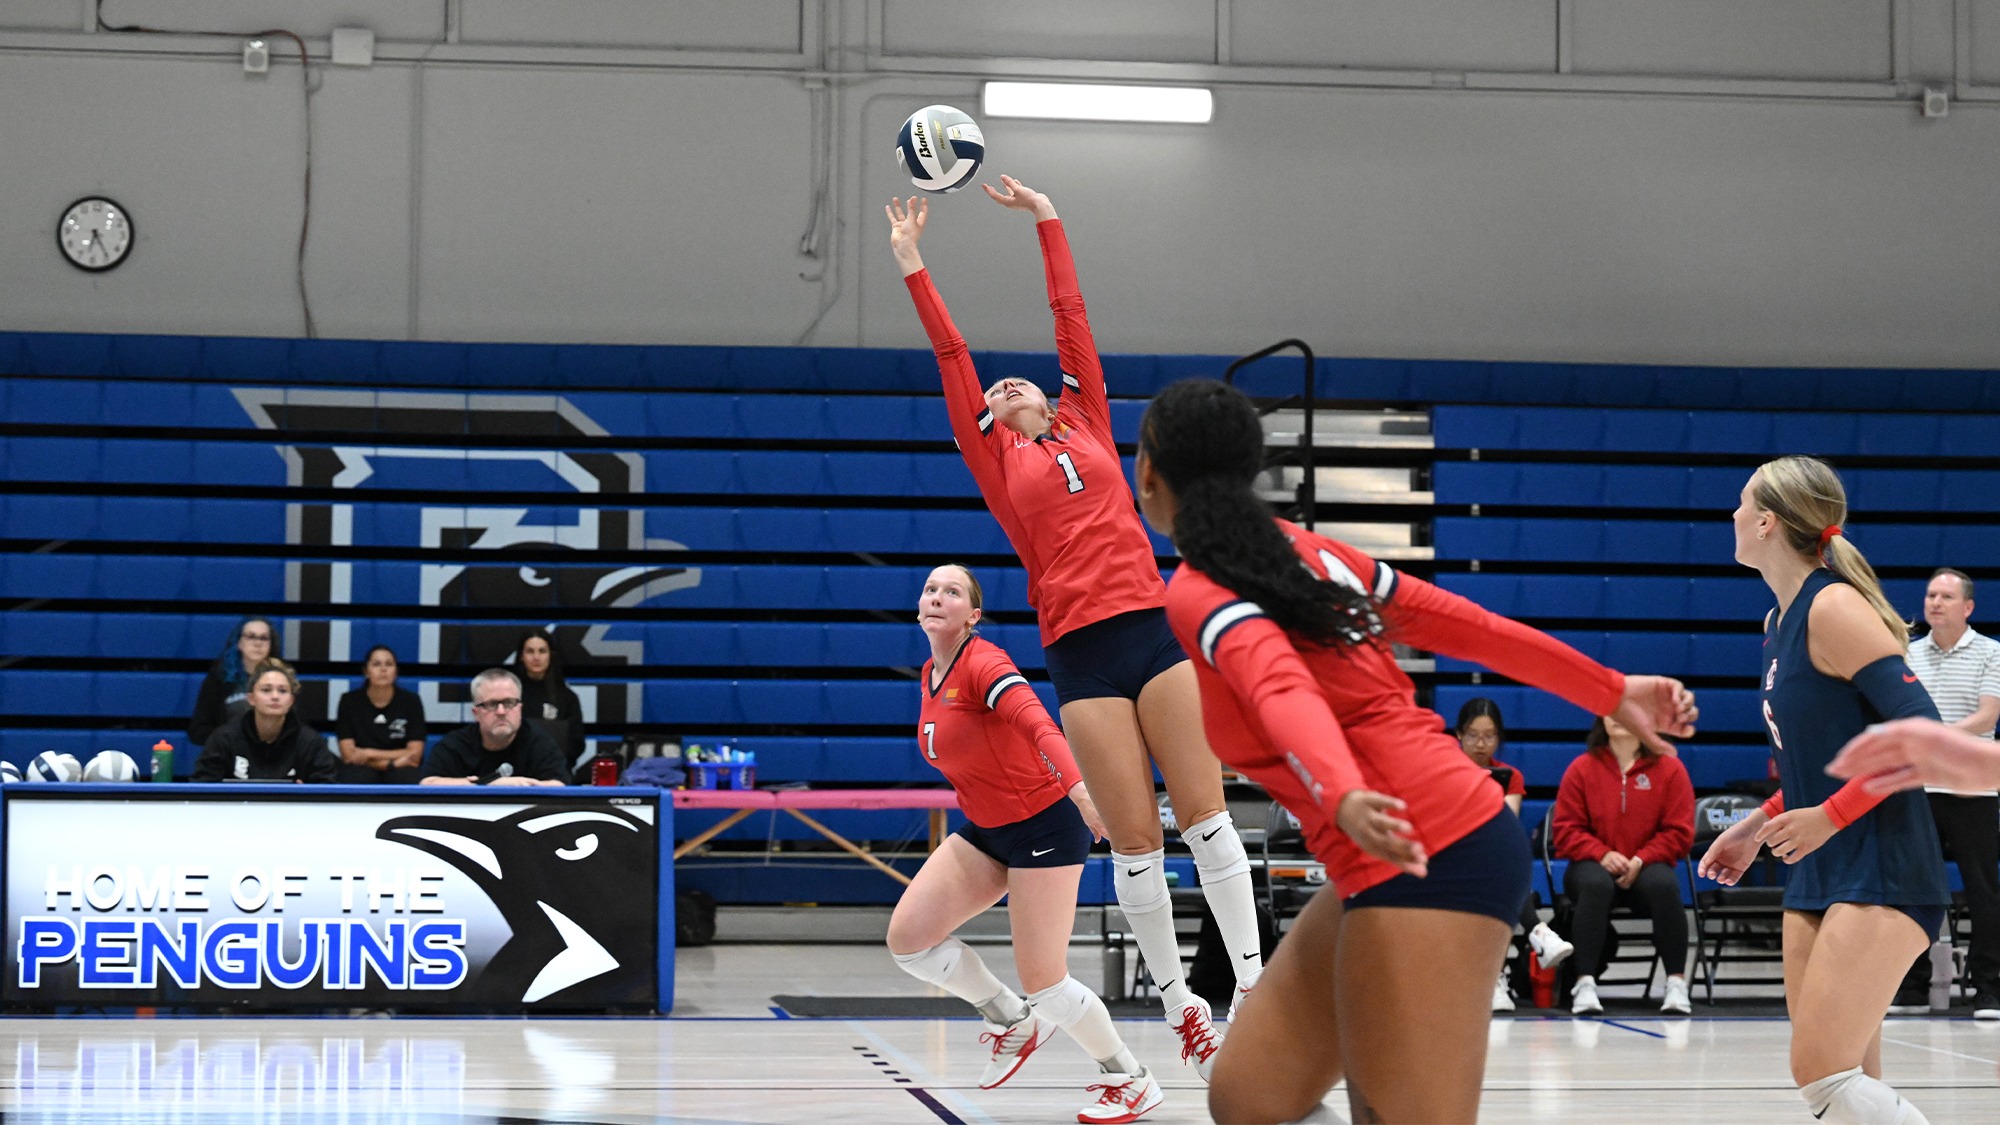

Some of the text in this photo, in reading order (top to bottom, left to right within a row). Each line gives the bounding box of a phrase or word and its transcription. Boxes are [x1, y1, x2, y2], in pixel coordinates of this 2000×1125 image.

[914, 121, 933, 158] Baden
[1056, 451, 1085, 494] 1
[923, 722, 938, 759] 7
[45, 864, 446, 914] HOME OF THE
[17, 915, 469, 990] PENGUINS
